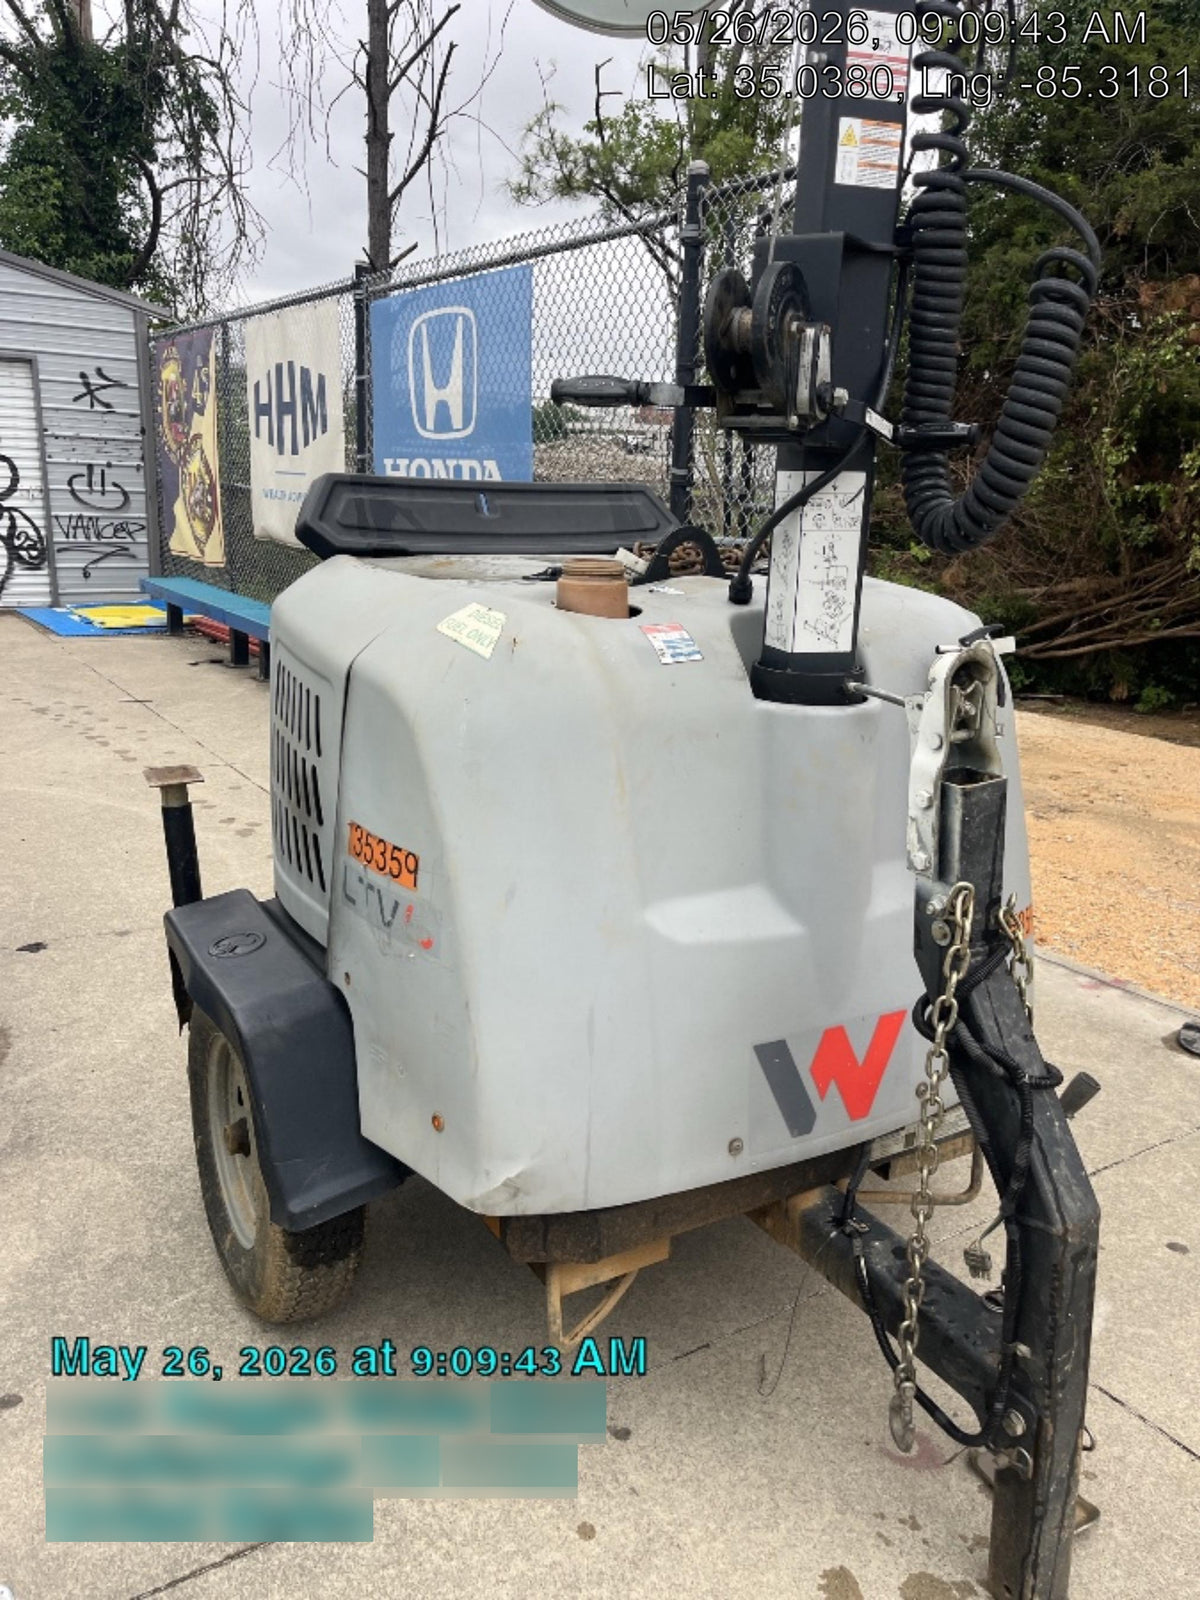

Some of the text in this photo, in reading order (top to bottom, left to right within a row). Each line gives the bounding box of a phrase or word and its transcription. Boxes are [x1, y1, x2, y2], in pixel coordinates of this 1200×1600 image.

[254, 361, 328, 456] HHM
[383, 458, 502, 481] HONDA
[353, 825, 419, 888] 35359
